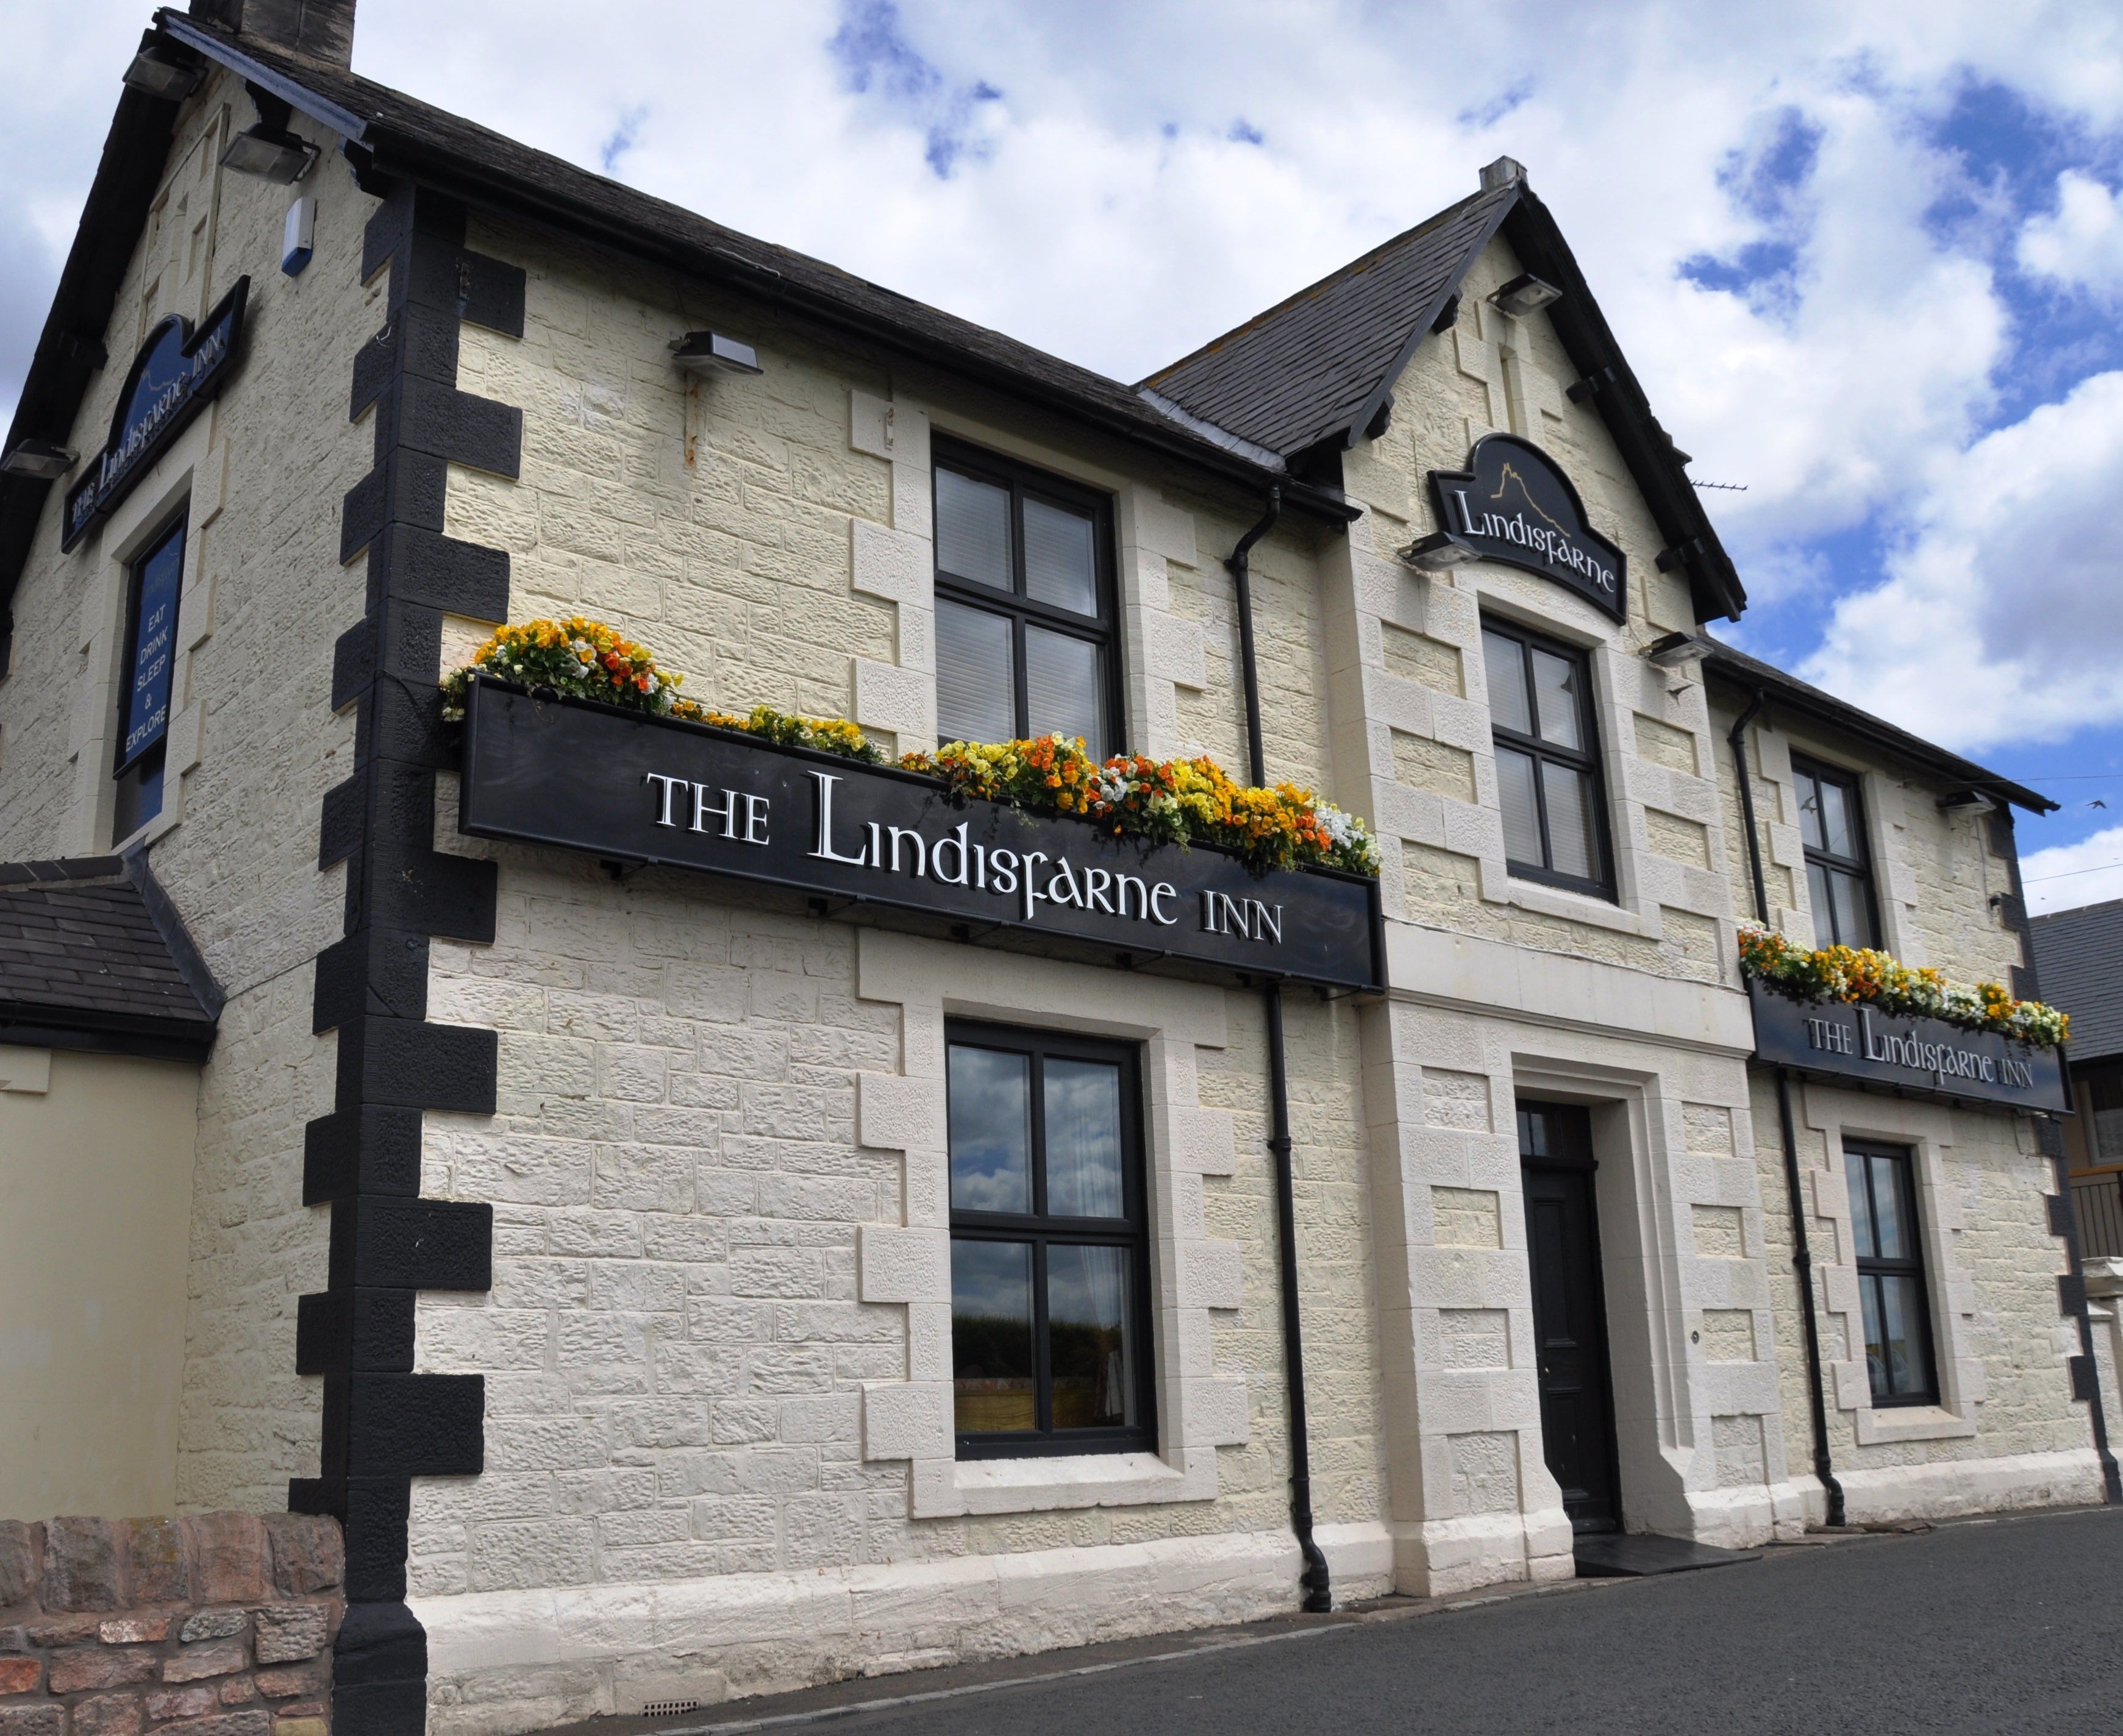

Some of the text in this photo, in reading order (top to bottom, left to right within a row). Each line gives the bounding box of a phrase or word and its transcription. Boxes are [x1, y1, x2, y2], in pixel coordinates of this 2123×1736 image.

[72, 482, 95, 523] THE
[193, 326, 222, 380] INN
[1454, 489, 1615, 592] Lindisfarne
[148, 604, 166, 633] EAT
[140, 626, 168, 665] DRINK
[137, 655, 166, 692] SLEEP
[145, 693, 152, 710] &
[126, 705, 166, 752] EXPLORE
[647, 770, 1284, 944] THE Lindisfarne INN
[1809, 1007, 2034, 1089] THE Lindisfarne INN
